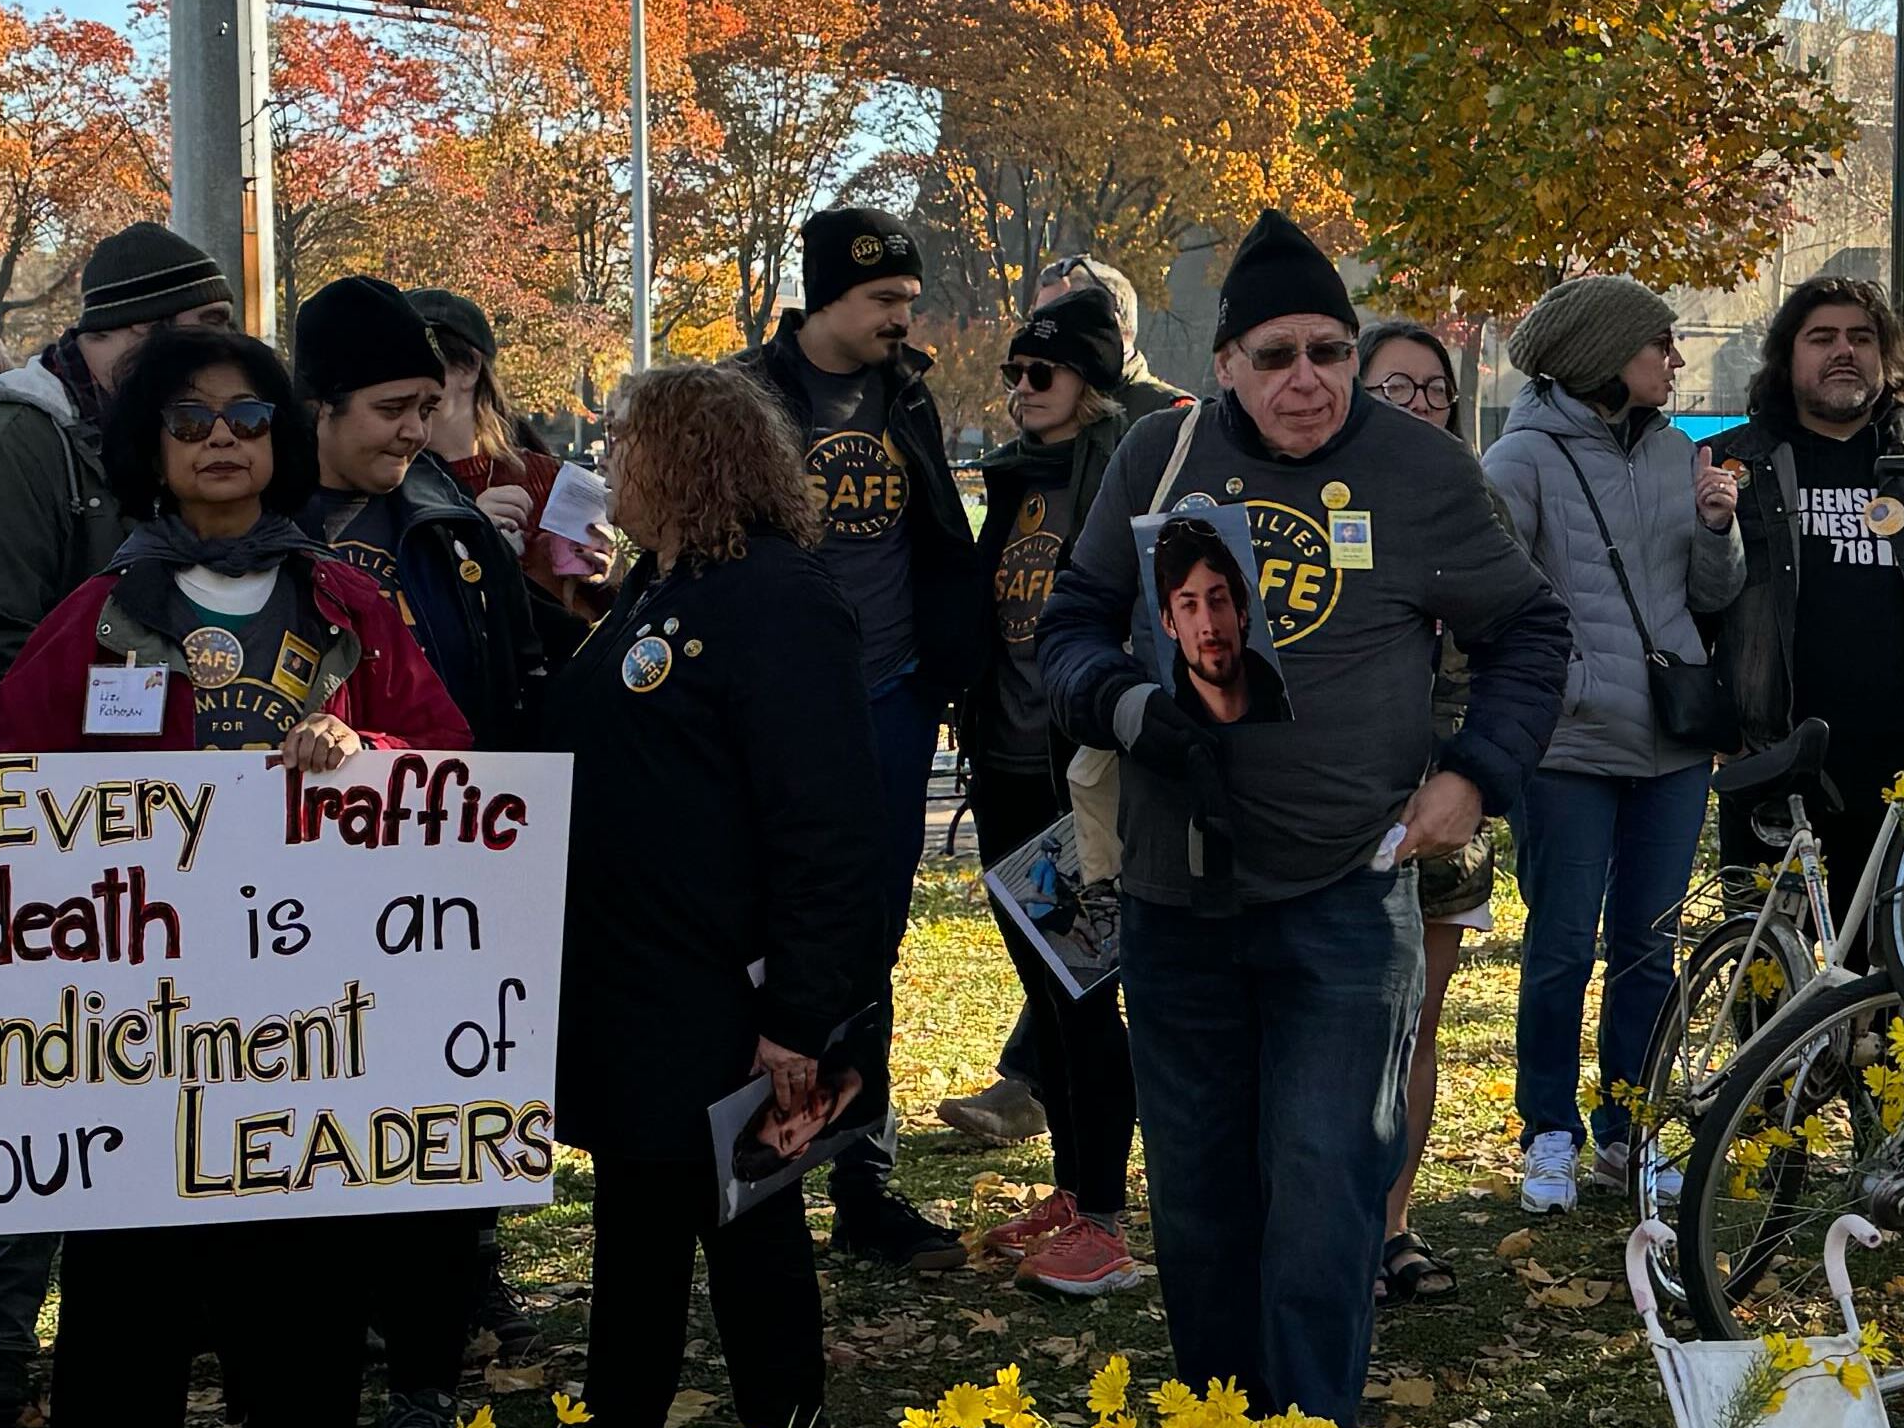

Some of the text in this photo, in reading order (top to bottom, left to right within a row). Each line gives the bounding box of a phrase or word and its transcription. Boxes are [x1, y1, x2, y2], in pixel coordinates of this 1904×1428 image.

[805, 474, 902, 510] SAFE
[1247, 511, 1323, 558] ILIES
[1798, 511, 1870, 539] INEST
[348, 549, 397, 578] ILIE
[1830, 538, 1874, 566] 718
[1259, 557, 1327, 613] FE
[185, 645, 239, 673] SAFE
[631, 644, 662, 684] SAFE
[194, 689, 296, 733] MILIES
[211, 721, 245, 733] FOR
[265, 752, 530, 852] Traffic
[238, 884, 313, 961] is
[374, 892, 482, 956] an
[443, 977, 527, 1079] of
[175, 1082, 555, 1200] LEADERS
